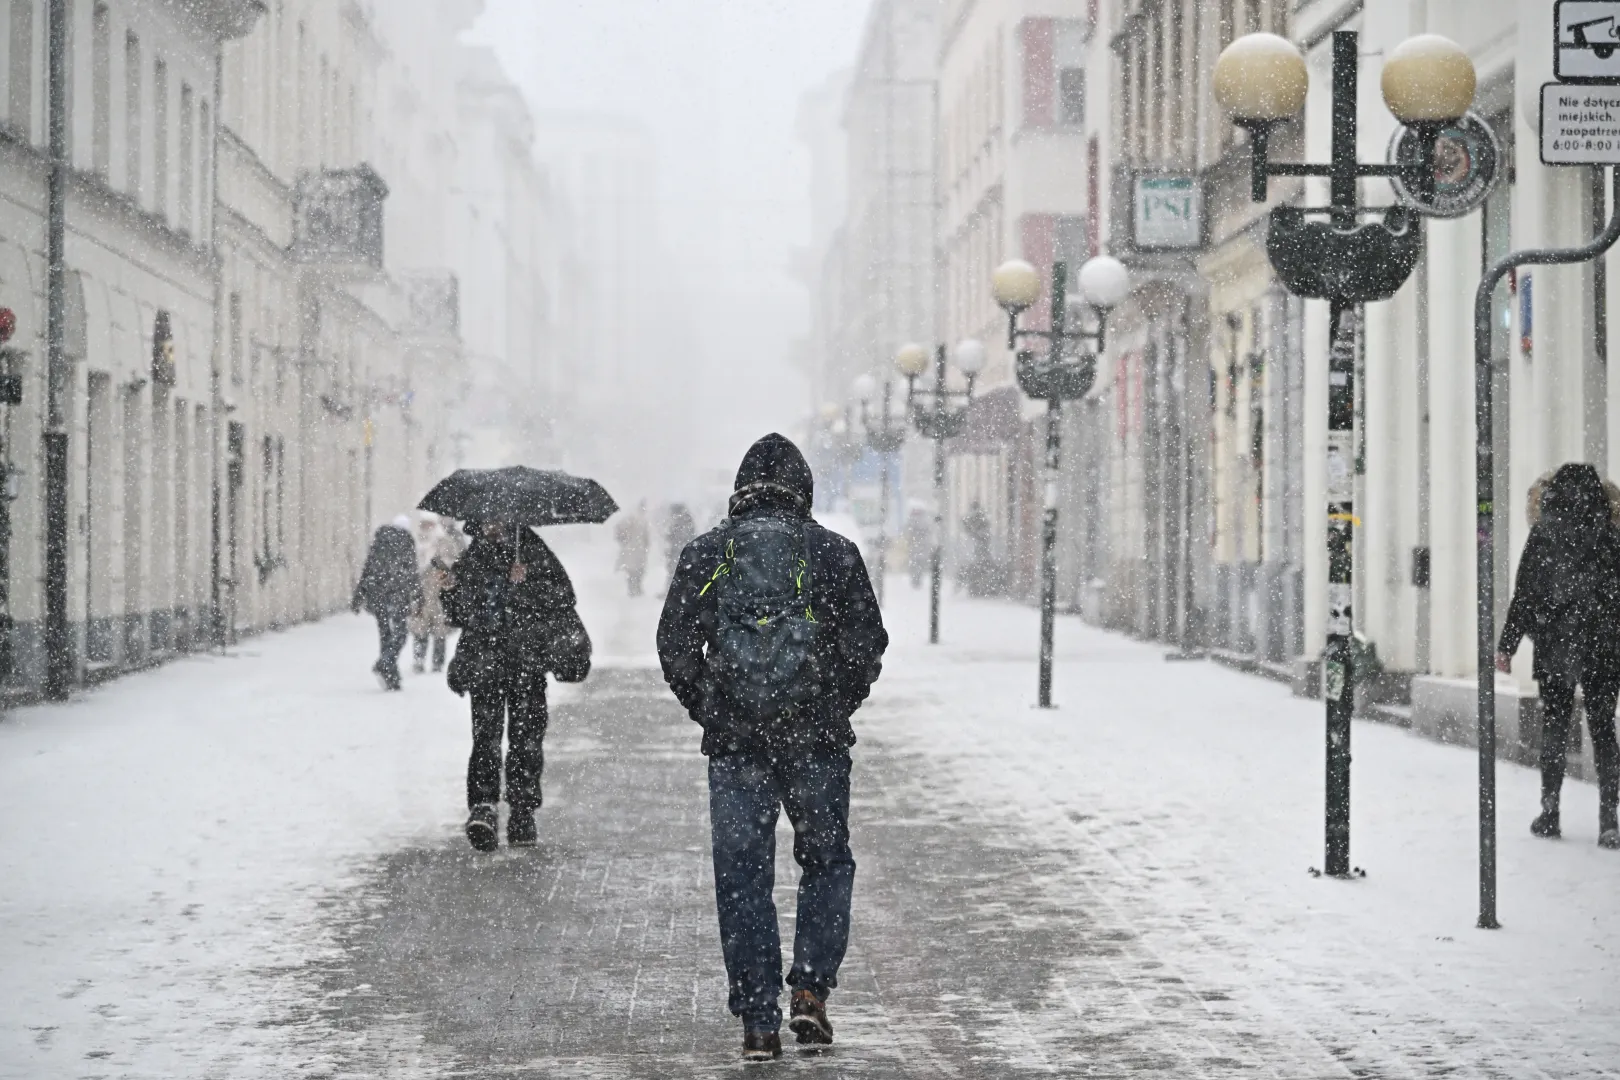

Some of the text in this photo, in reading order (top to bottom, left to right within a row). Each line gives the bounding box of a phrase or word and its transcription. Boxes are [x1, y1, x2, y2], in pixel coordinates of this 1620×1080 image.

[1559, 96, 1579, 107] Nie
[1558, 111, 1616, 124] miejskich.
[1553, 140, 1612, 150] 6:00-8:00
